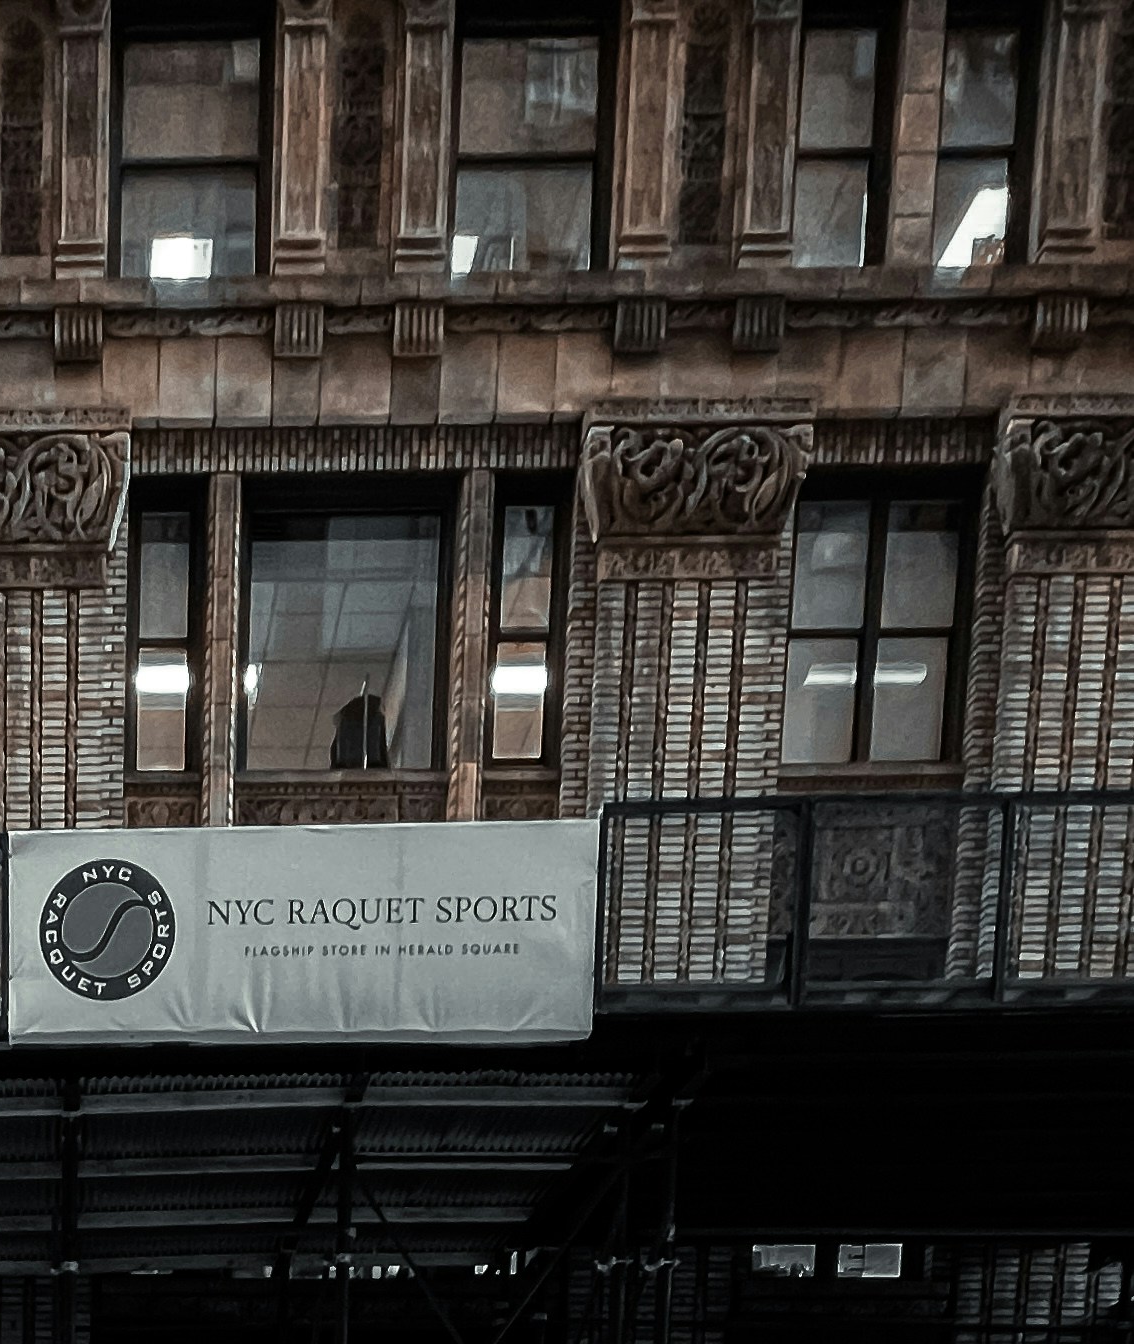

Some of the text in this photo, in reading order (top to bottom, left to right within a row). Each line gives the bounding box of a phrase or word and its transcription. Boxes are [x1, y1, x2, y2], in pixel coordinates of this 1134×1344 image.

[81, 865, 133, 882] NYC
[207, 895, 557, 930] NYC RAQUET SPORTS
[45, 890, 170, 996] RACQUET SPORTS
[244, 943, 519, 957] FLAGSHIP STORE IN HERALD SQUARE
